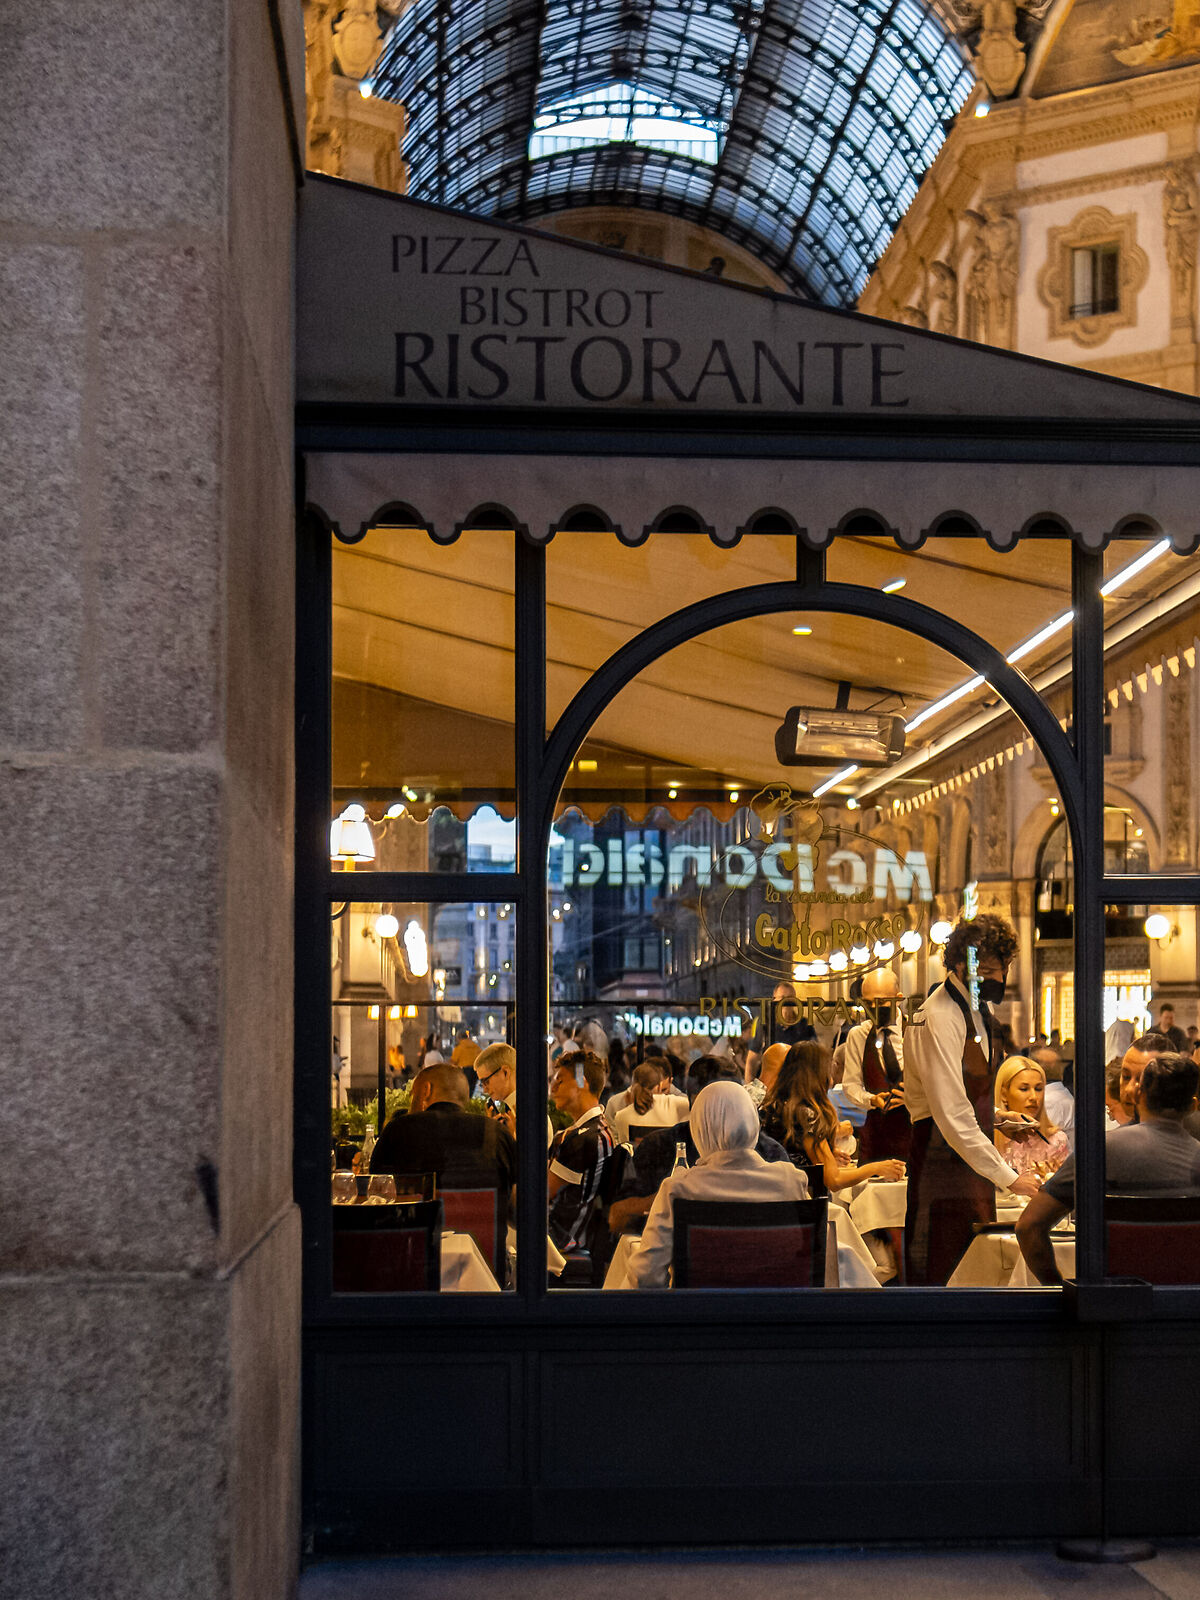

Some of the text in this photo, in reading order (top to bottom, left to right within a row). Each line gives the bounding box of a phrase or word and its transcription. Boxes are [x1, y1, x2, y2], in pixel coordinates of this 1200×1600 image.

[391, 234, 540, 278] PIZZA
[459, 287, 663, 330] BISTROT
[394, 332, 910, 407] RISTORANTE
[755, 912, 906, 957] Gatto Rosso
[699, 997, 926, 1027] RISTORANTE
